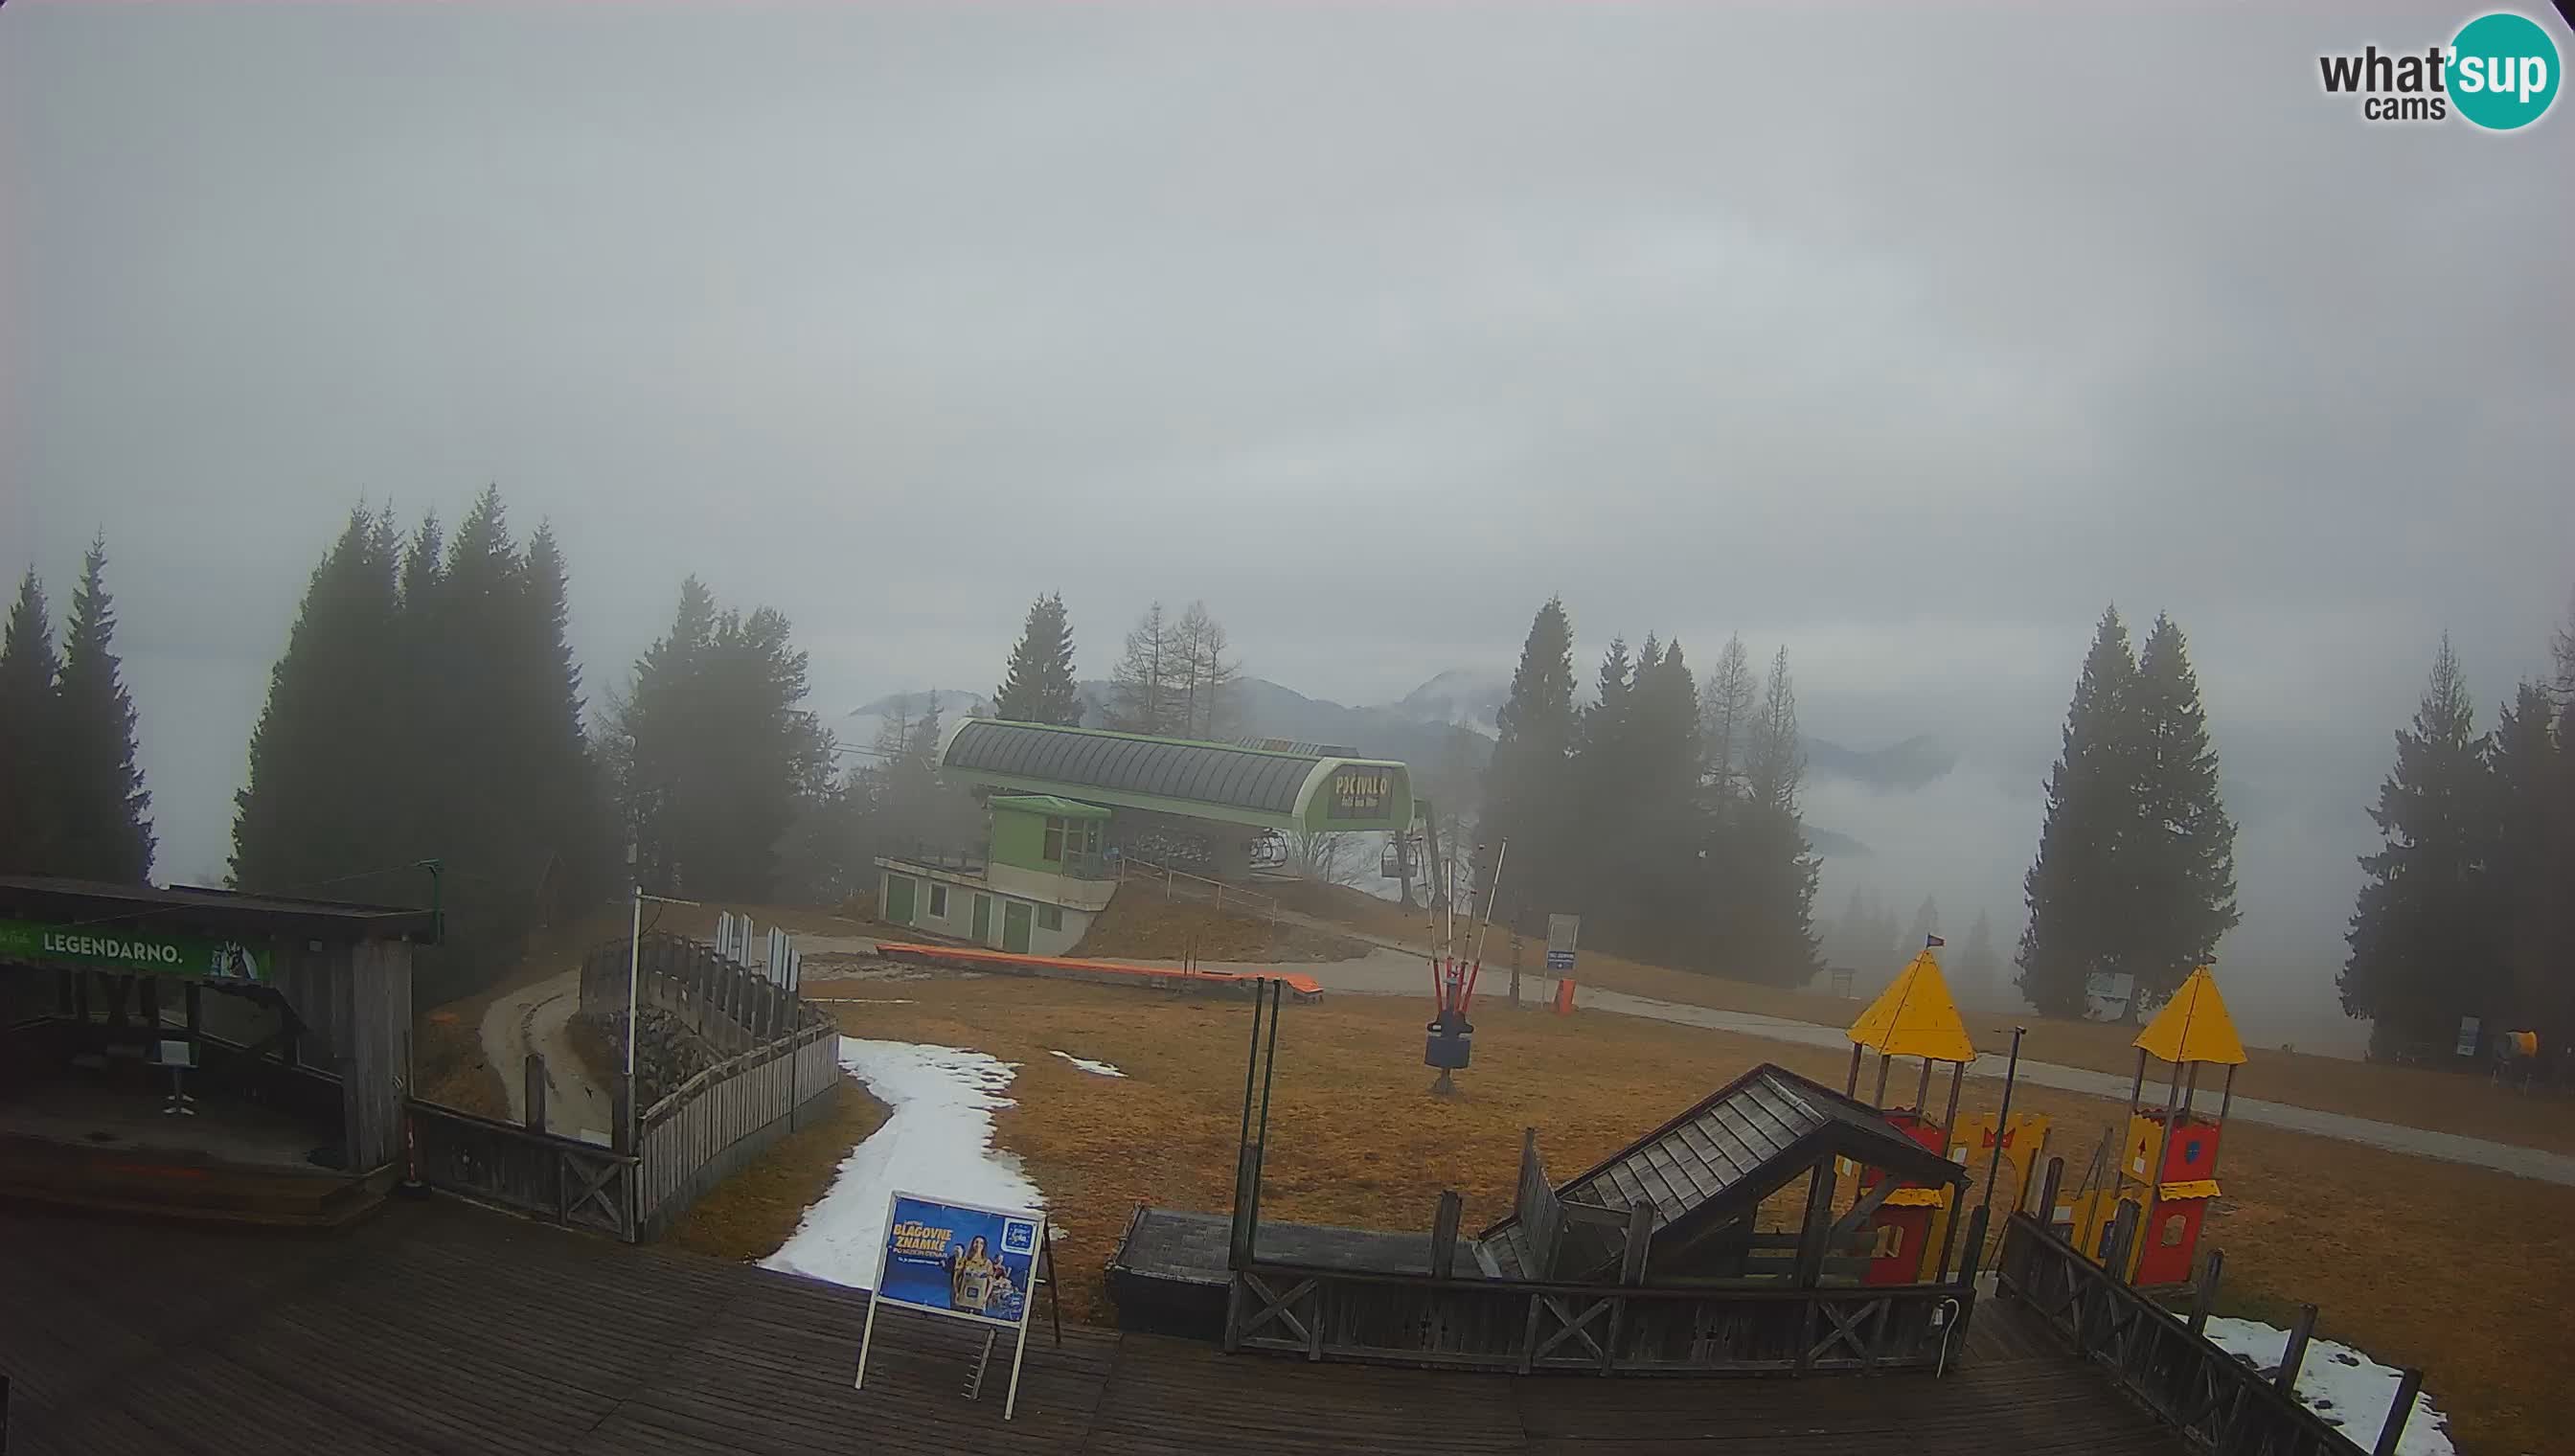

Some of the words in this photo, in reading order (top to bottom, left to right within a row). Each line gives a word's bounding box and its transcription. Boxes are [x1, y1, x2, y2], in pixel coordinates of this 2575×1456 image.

[43, 932, 184, 964] LEGENDARNO.
[894, 1223, 953, 1240] BLAGOVNE
[896, 1237, 946, 1252] ZNAMKE
